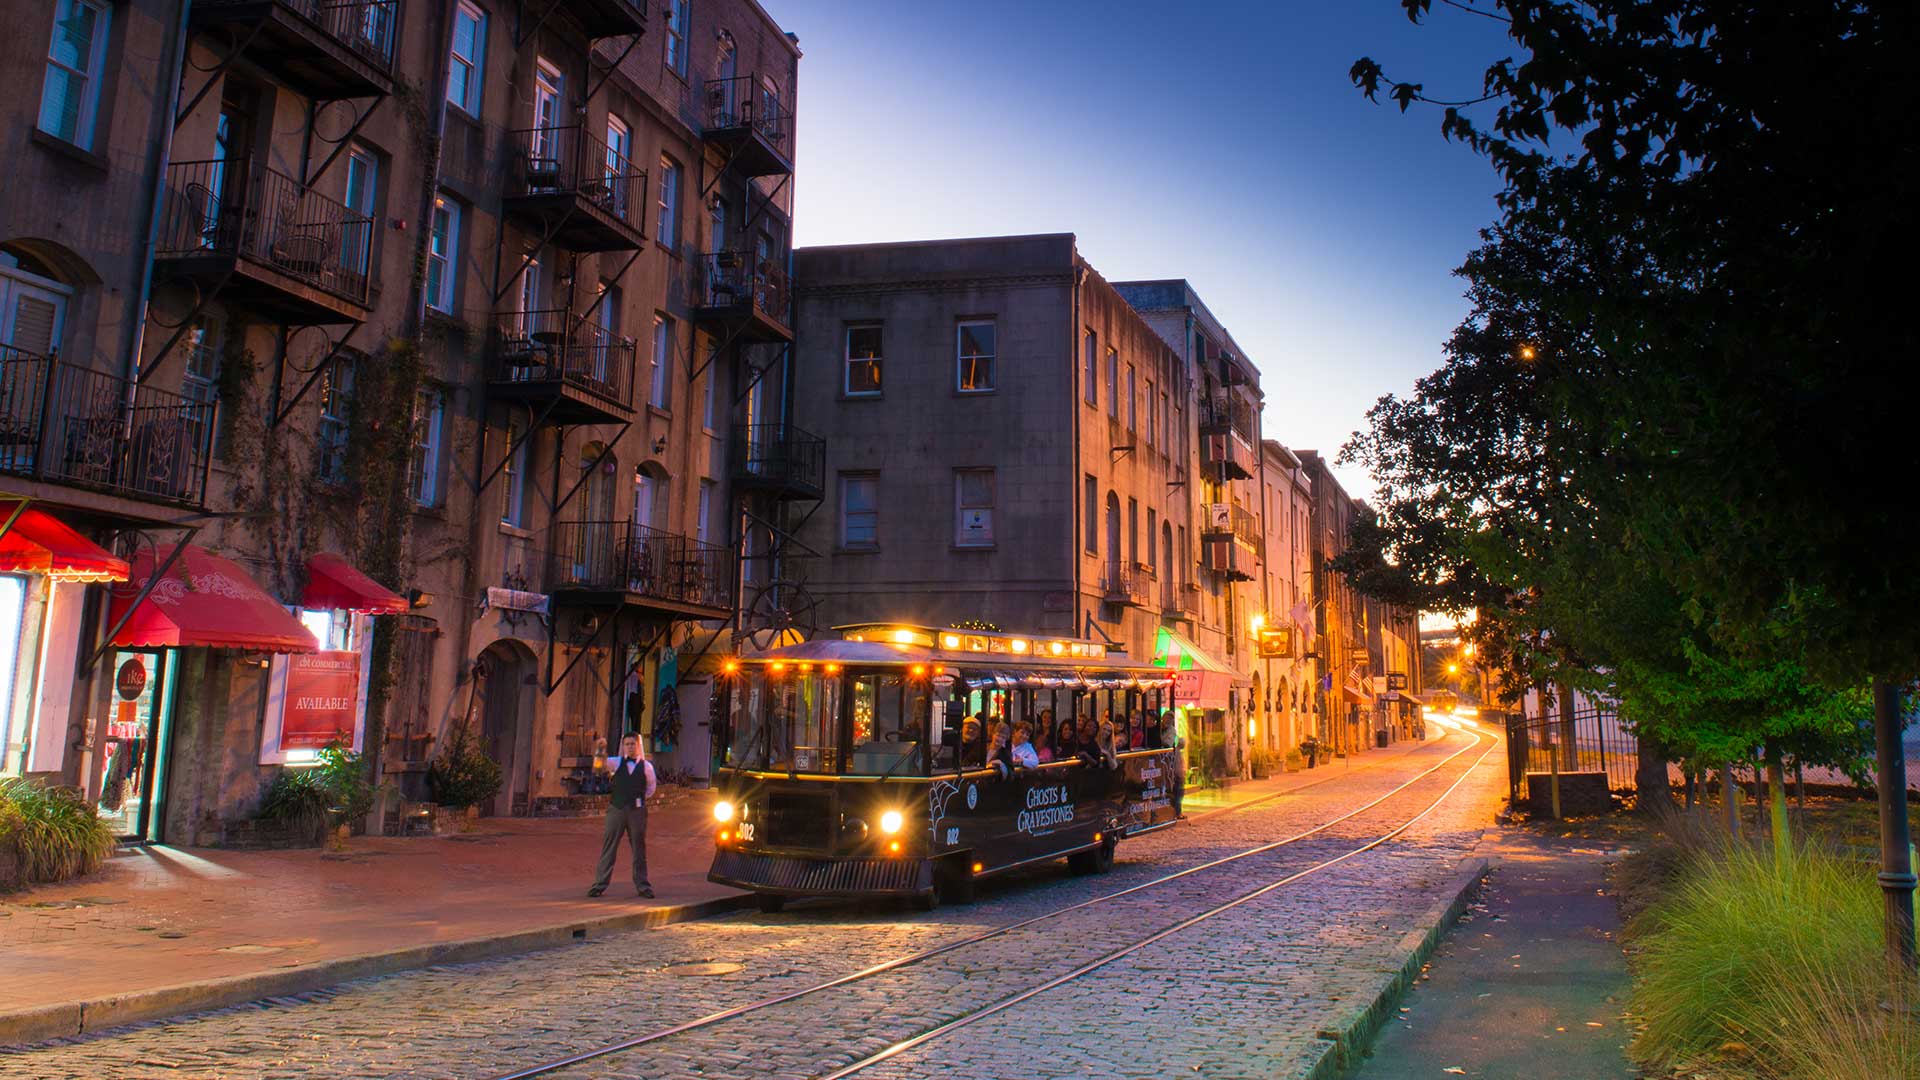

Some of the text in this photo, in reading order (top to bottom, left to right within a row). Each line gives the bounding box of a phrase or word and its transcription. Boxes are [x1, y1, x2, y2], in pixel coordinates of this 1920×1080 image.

[296, 697, 349, 710] AVAILABLE
[1026, 785, 1068, 809] GHOSTS &
[1017, 804, 1074, 834] GRAVESTONES
